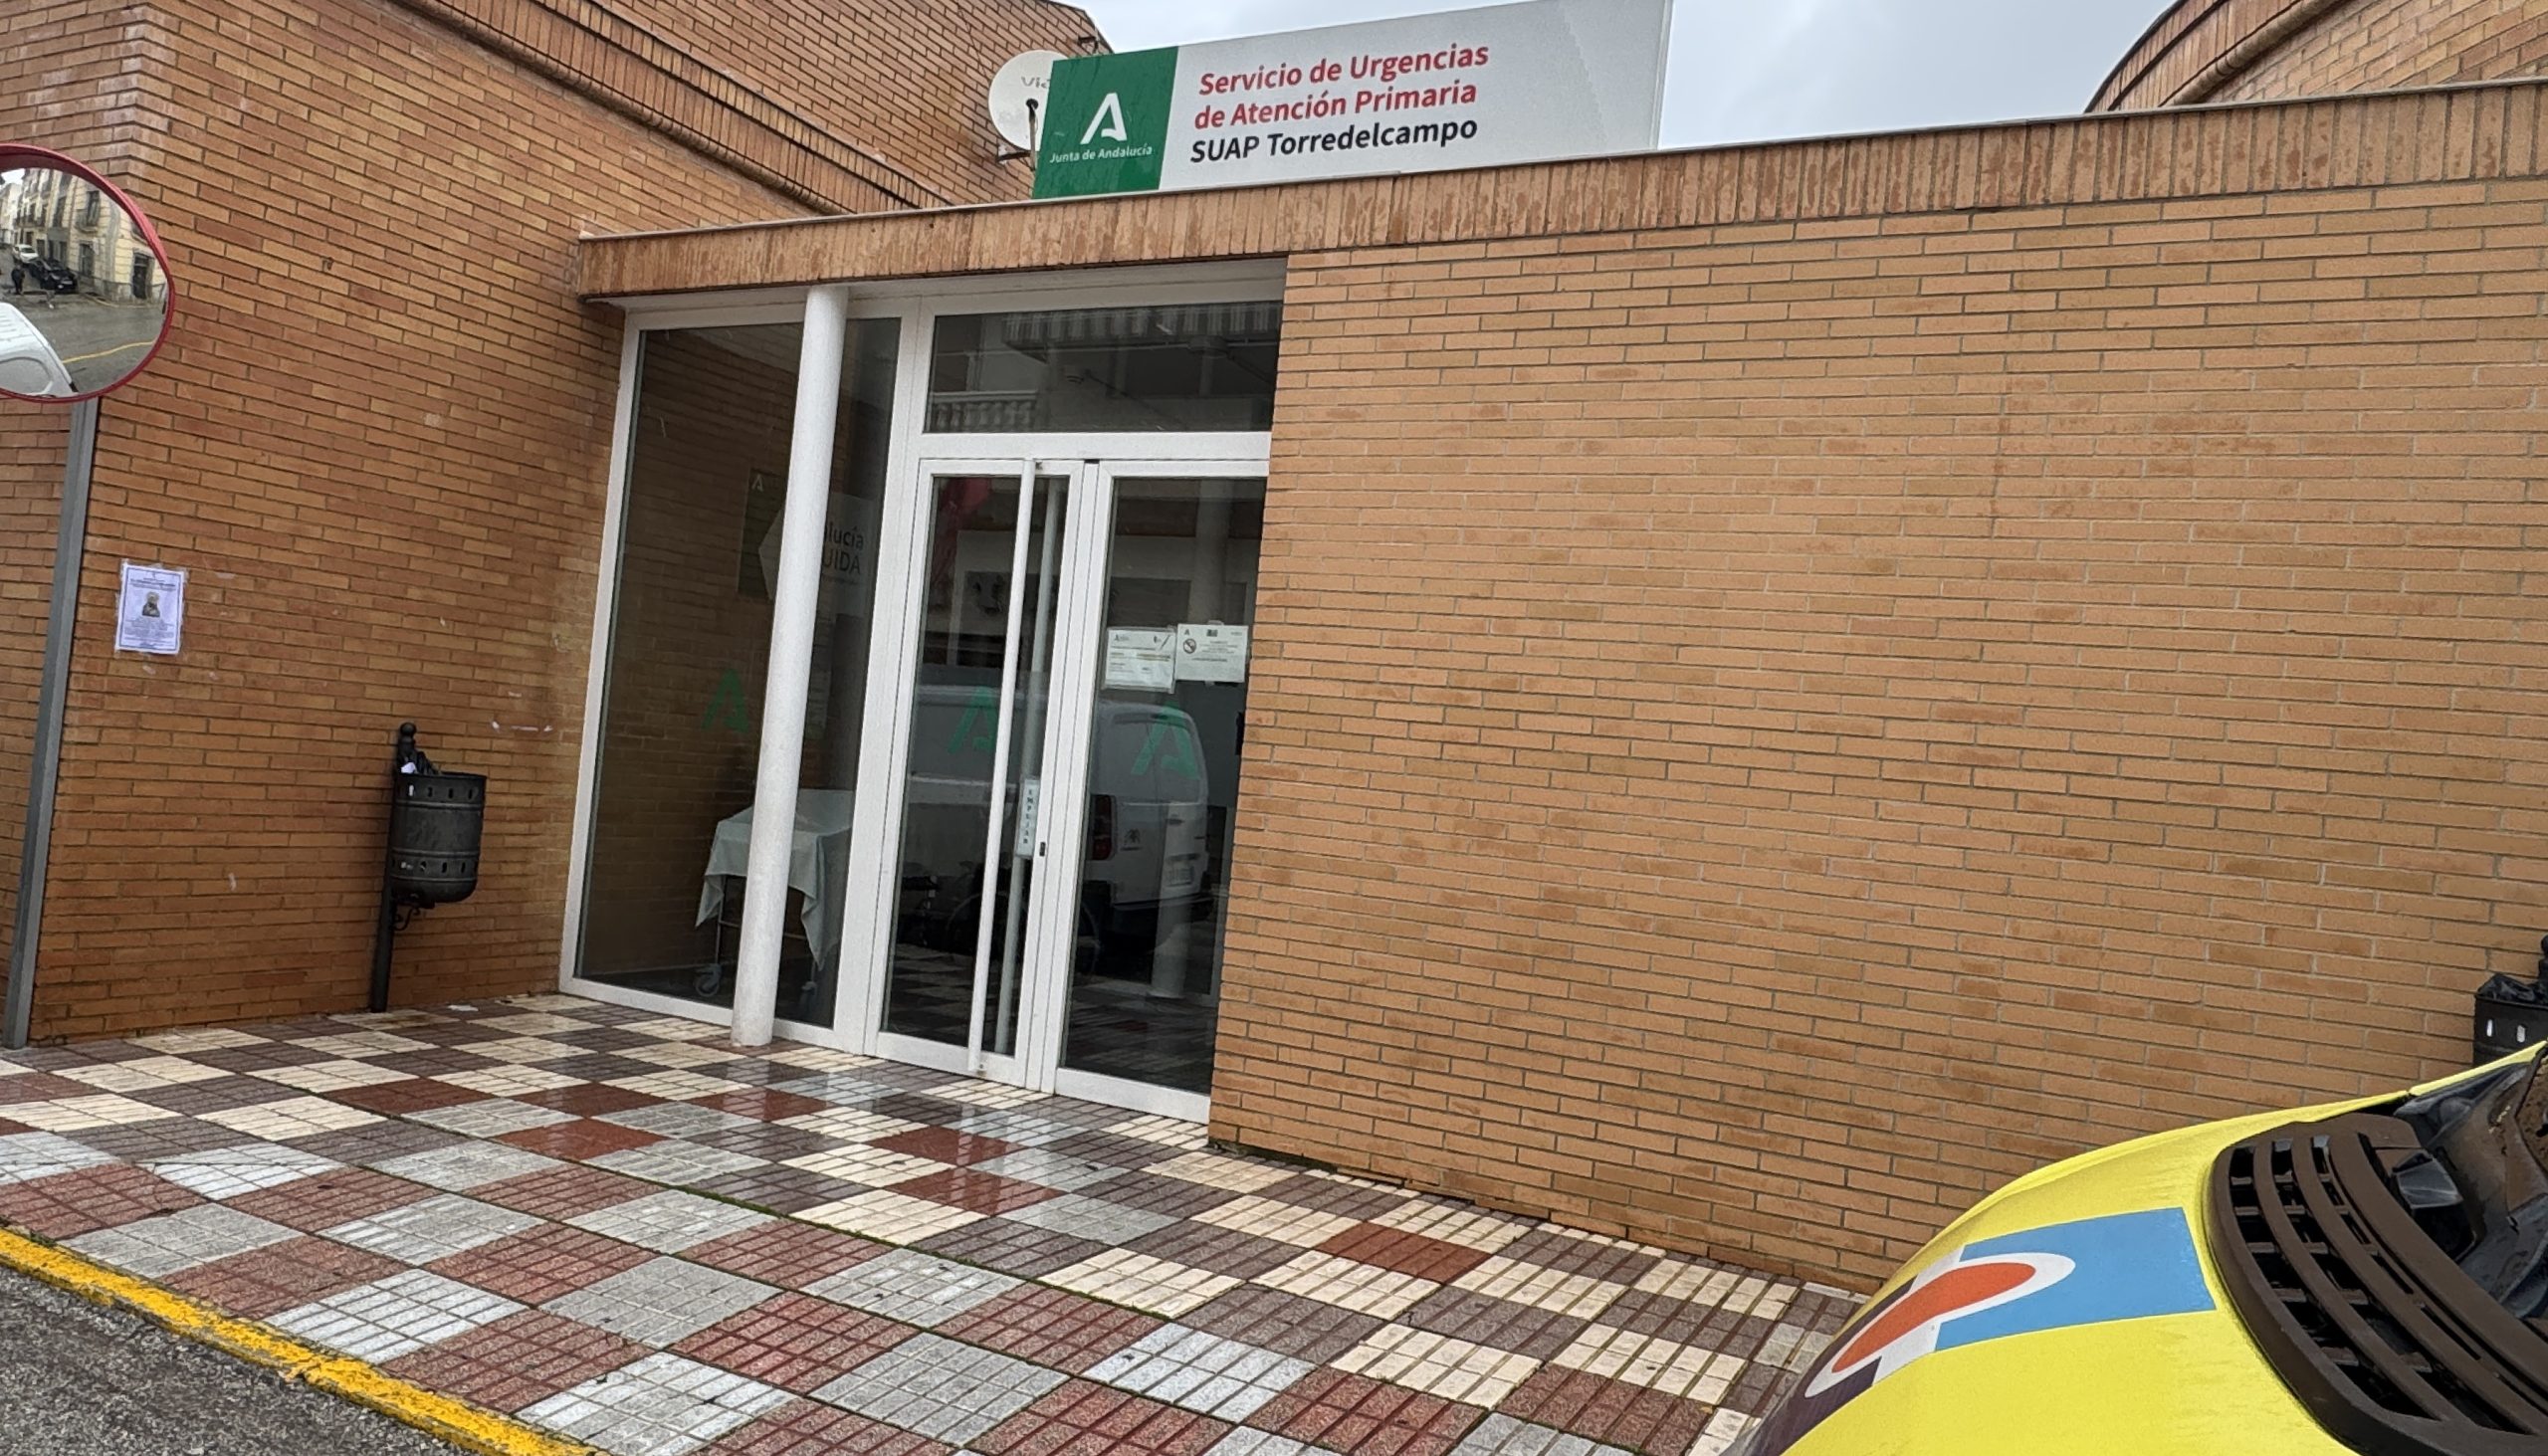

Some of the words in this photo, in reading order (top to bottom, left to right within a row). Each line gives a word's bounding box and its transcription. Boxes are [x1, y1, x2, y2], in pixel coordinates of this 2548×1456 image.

[1199, 62, 1303, 96] Servicio
[1310, 58, 1342, 84] de
[1350, 43, 1489, 83] Urgencias
[1194, 104, 1225, 130] de
[1230, 90, 1347, 126] Atención
[1355, 79, 1477, 113] Primaria
[1049, 151, 1080, 163] Junta
[1082, 148, 1096, 160] de
[1098, 143, 1153, 158] Andalucía
[1190, 135, 1260, 163] SUAP
[1267, 119, 1478, 156] Torredelcampo
